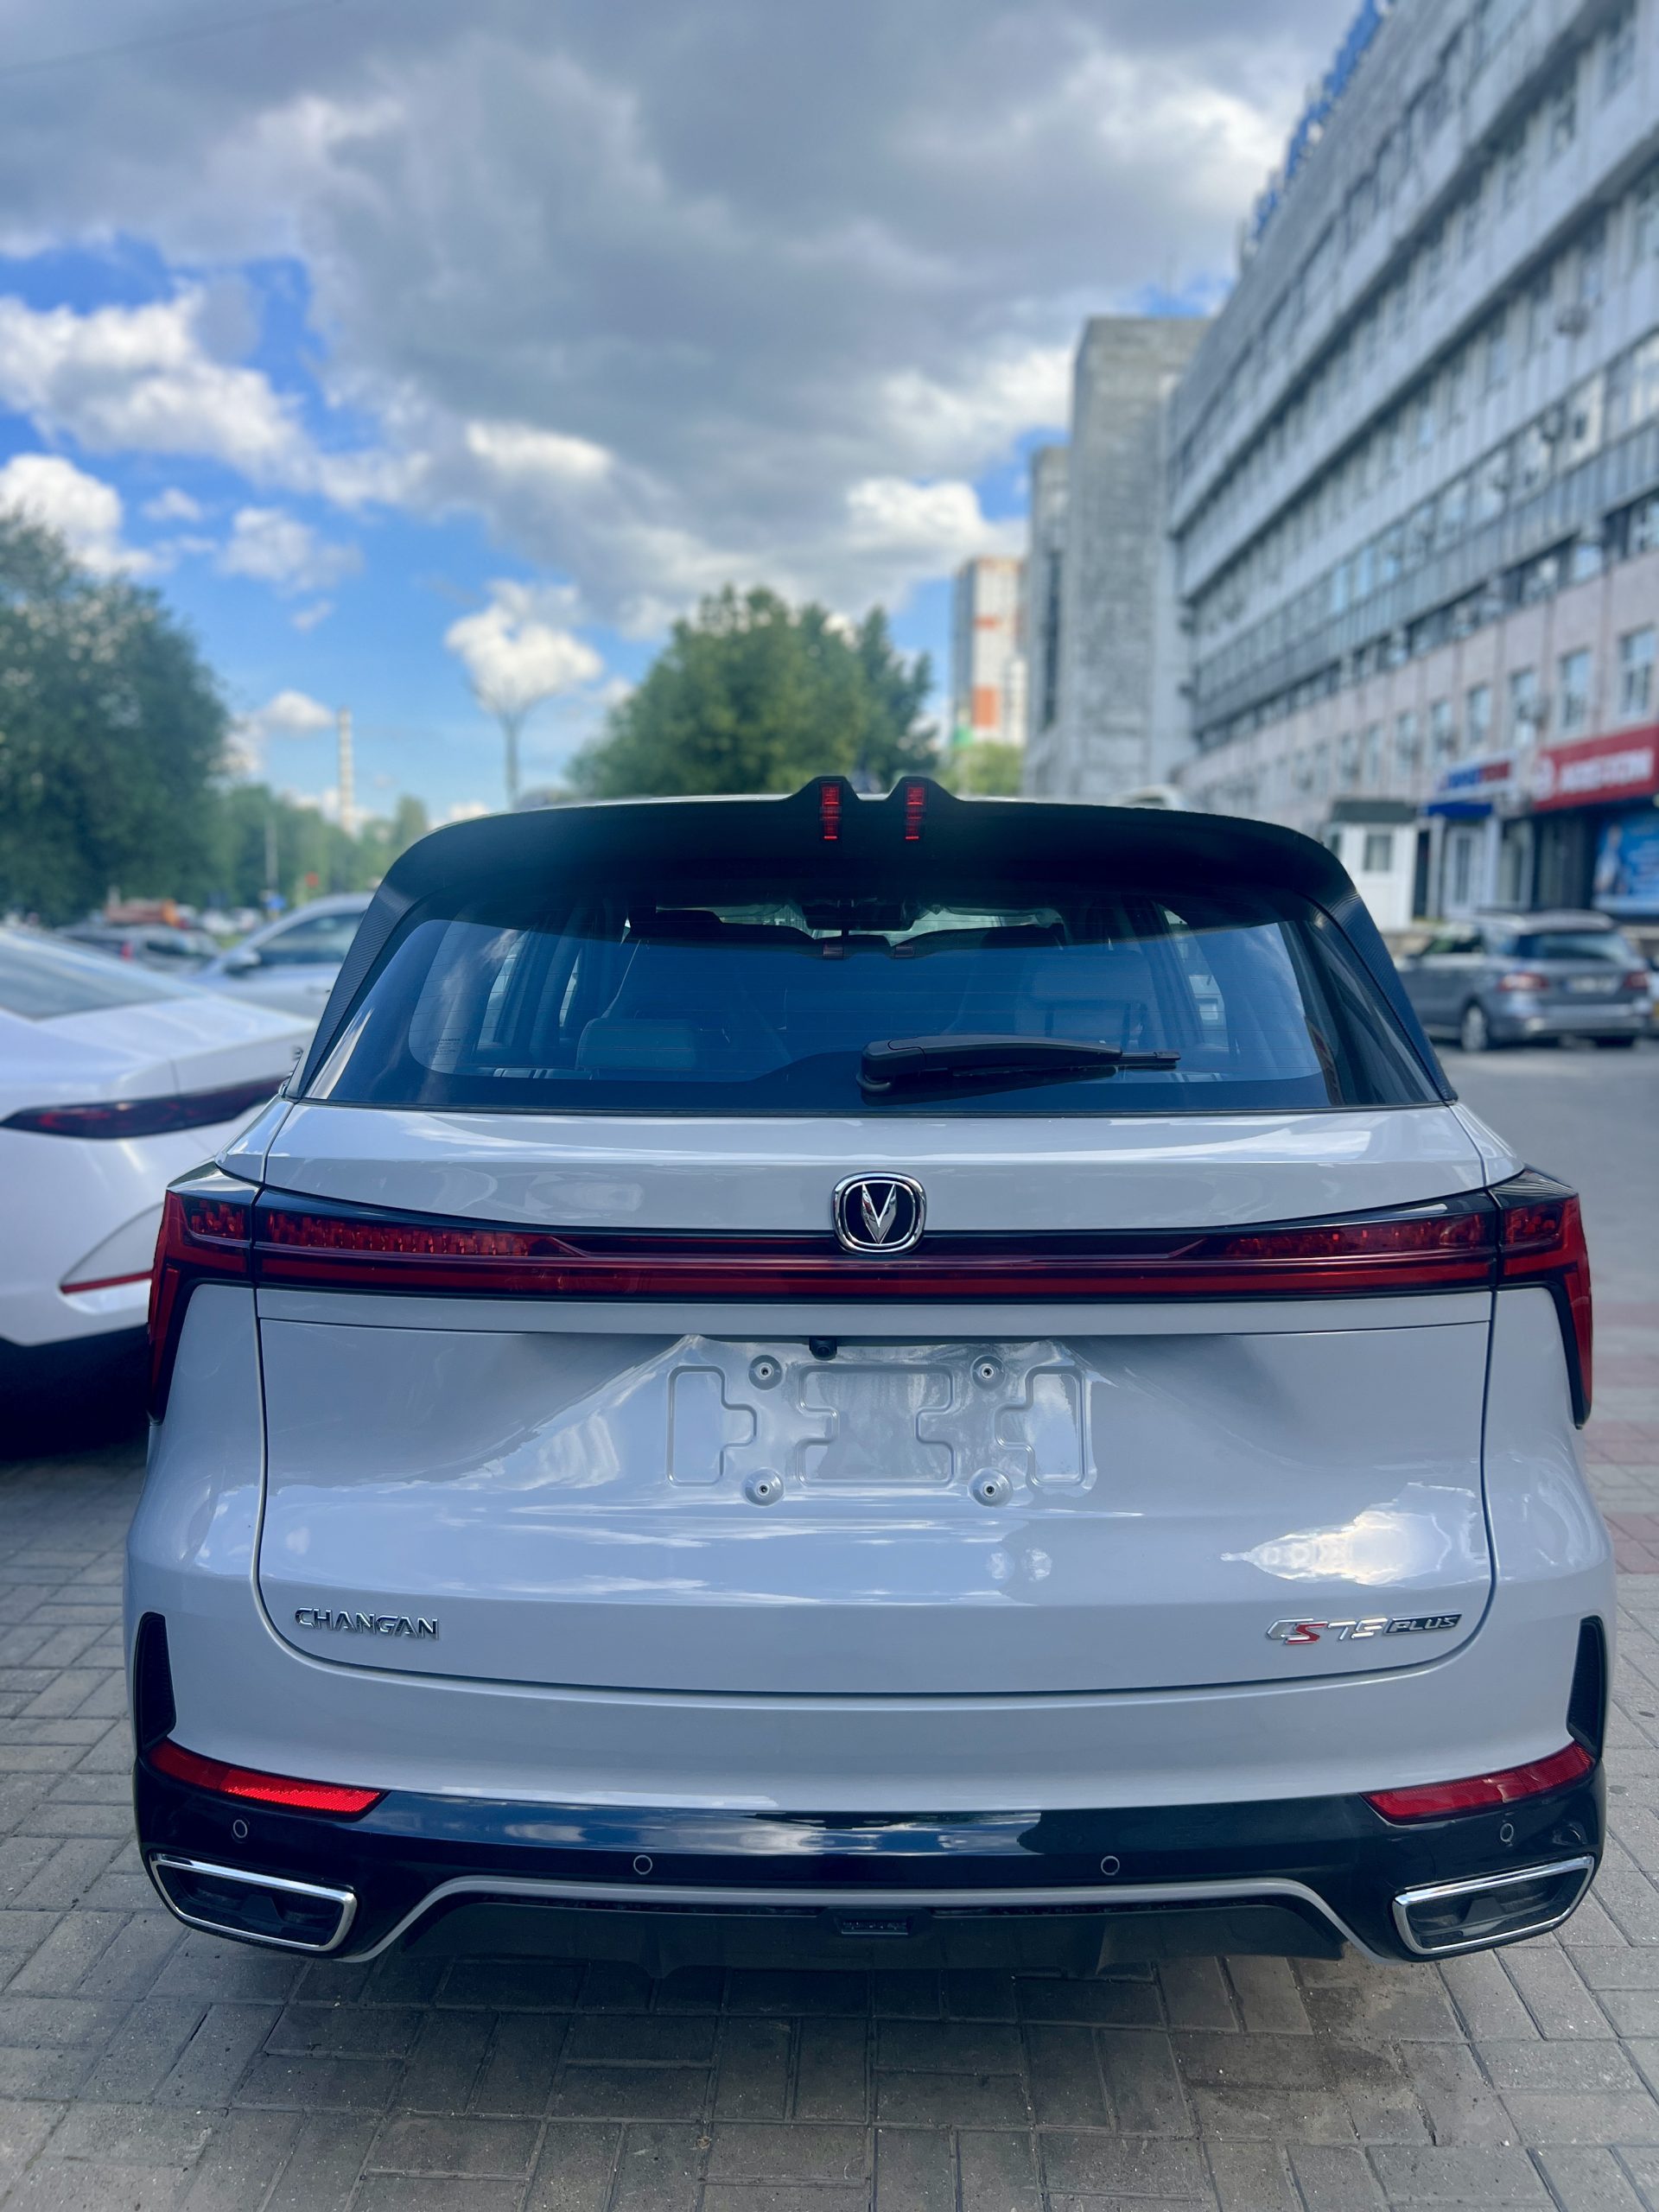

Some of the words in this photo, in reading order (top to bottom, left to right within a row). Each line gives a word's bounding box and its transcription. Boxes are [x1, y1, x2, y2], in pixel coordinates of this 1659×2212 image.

[295, 1607, 440, 1641] CHANGAN
[1266, 1618, 1389, 1645] CS75
[1386, 1614, 1460, 1634] PLUS
